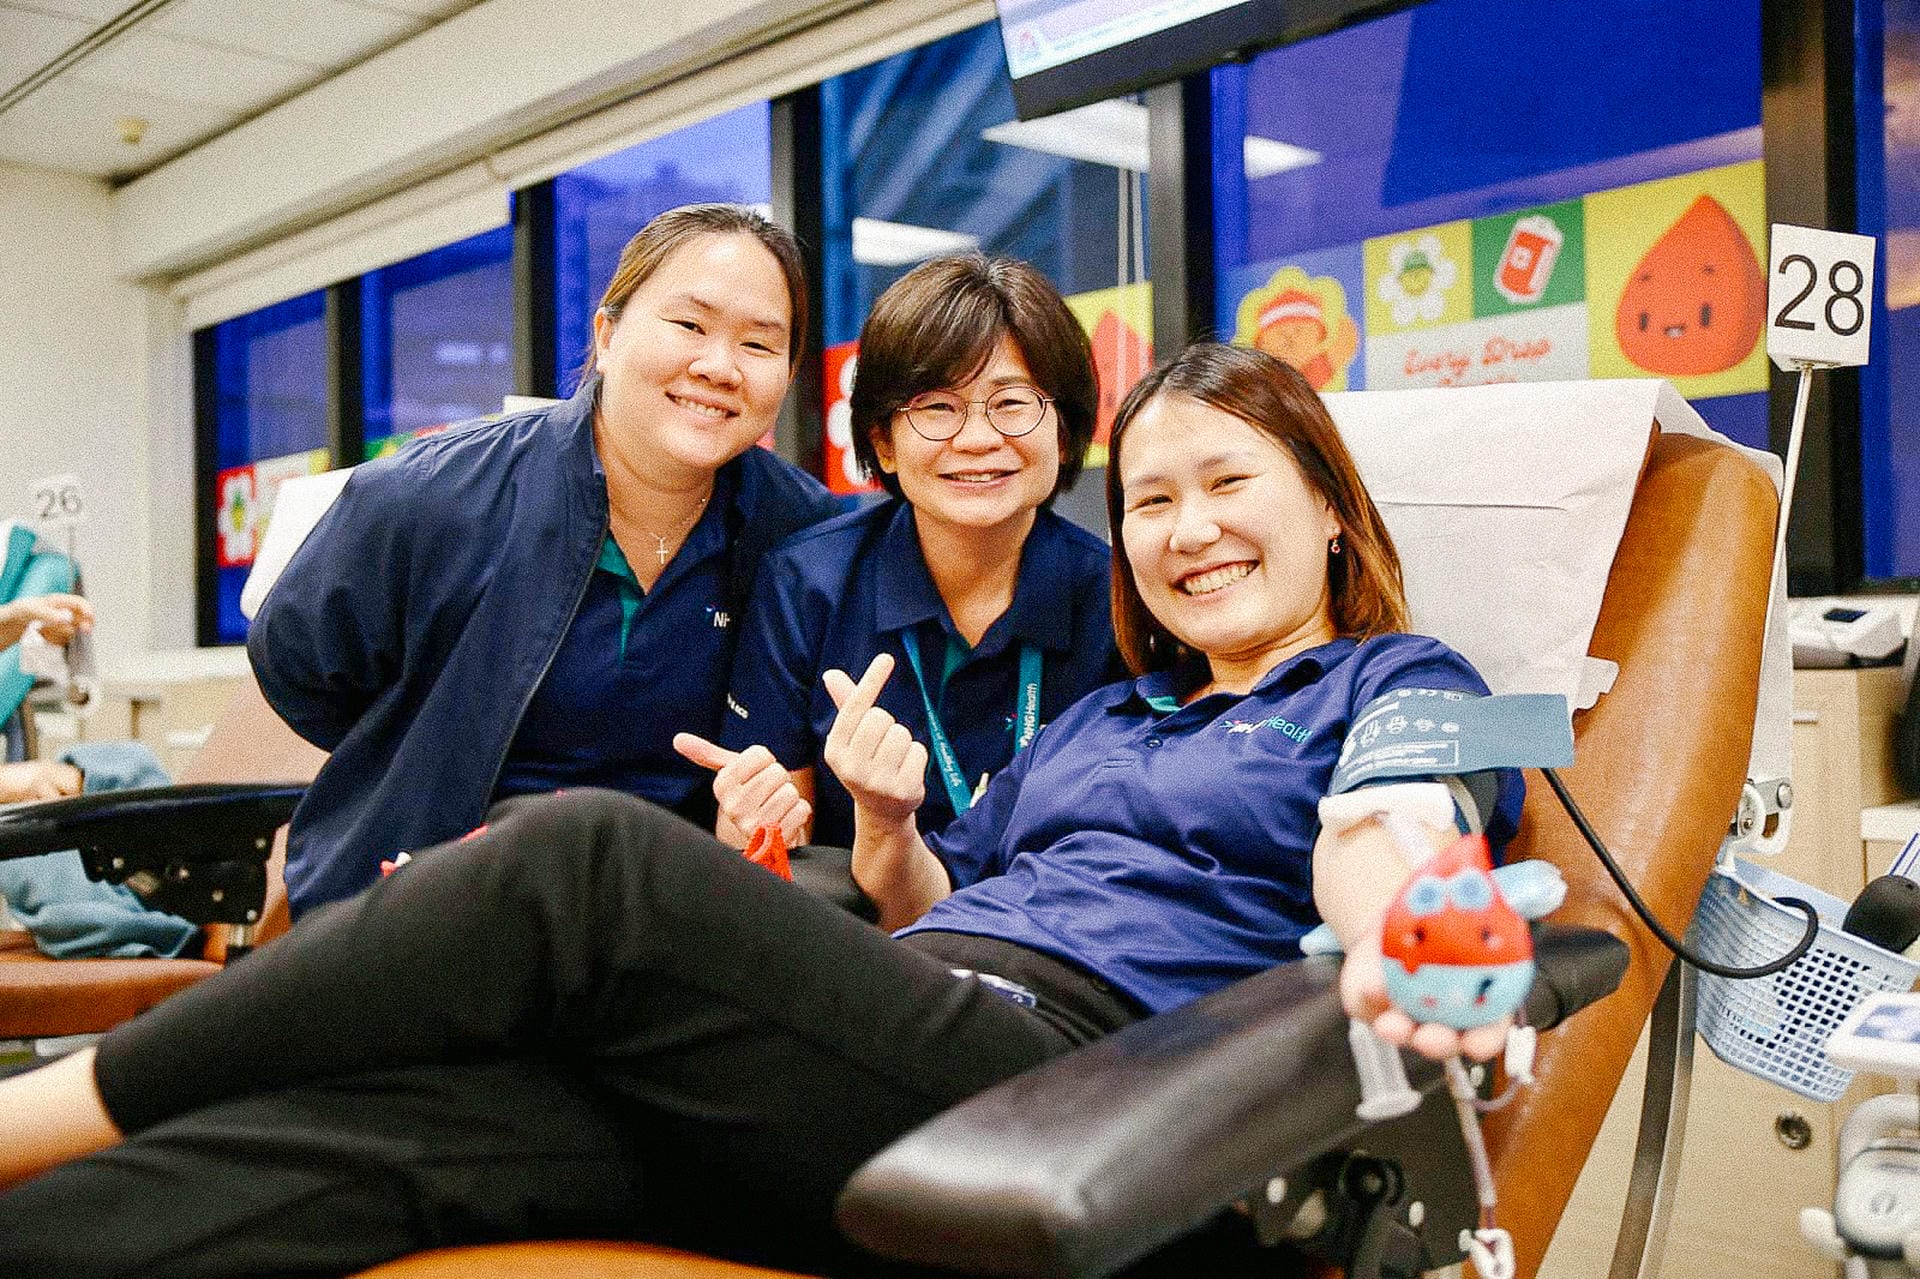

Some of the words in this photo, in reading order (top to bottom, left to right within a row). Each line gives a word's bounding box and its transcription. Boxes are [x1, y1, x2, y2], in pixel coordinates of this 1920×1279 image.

[1774, 254, 1864, 336] 28
[35, 485, 83, 521] 26
[713, 611, 730, 628] NH
